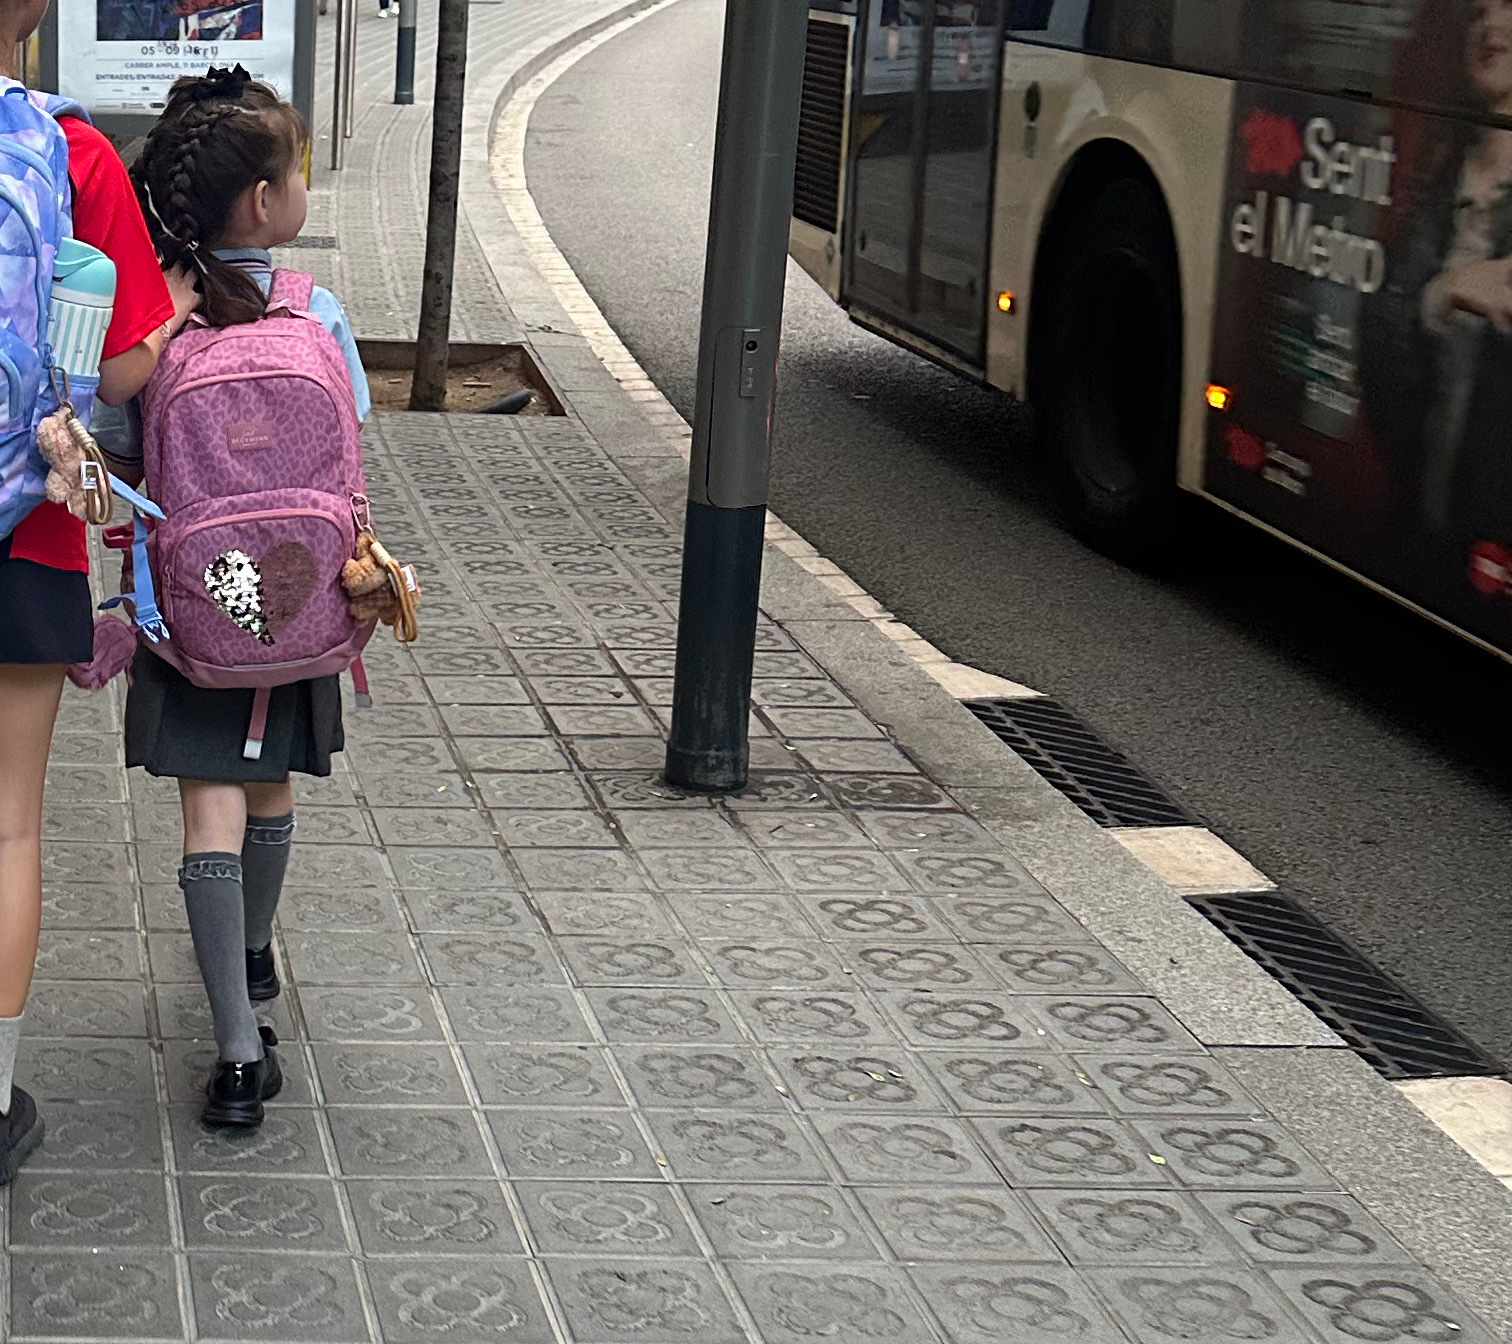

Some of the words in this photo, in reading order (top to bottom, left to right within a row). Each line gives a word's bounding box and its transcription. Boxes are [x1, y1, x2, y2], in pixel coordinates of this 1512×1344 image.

[1300, 117, 1397, 205] Sent
[1231, 190, 1268, 258] el
[1271, 195, 1385, 293] Metro
